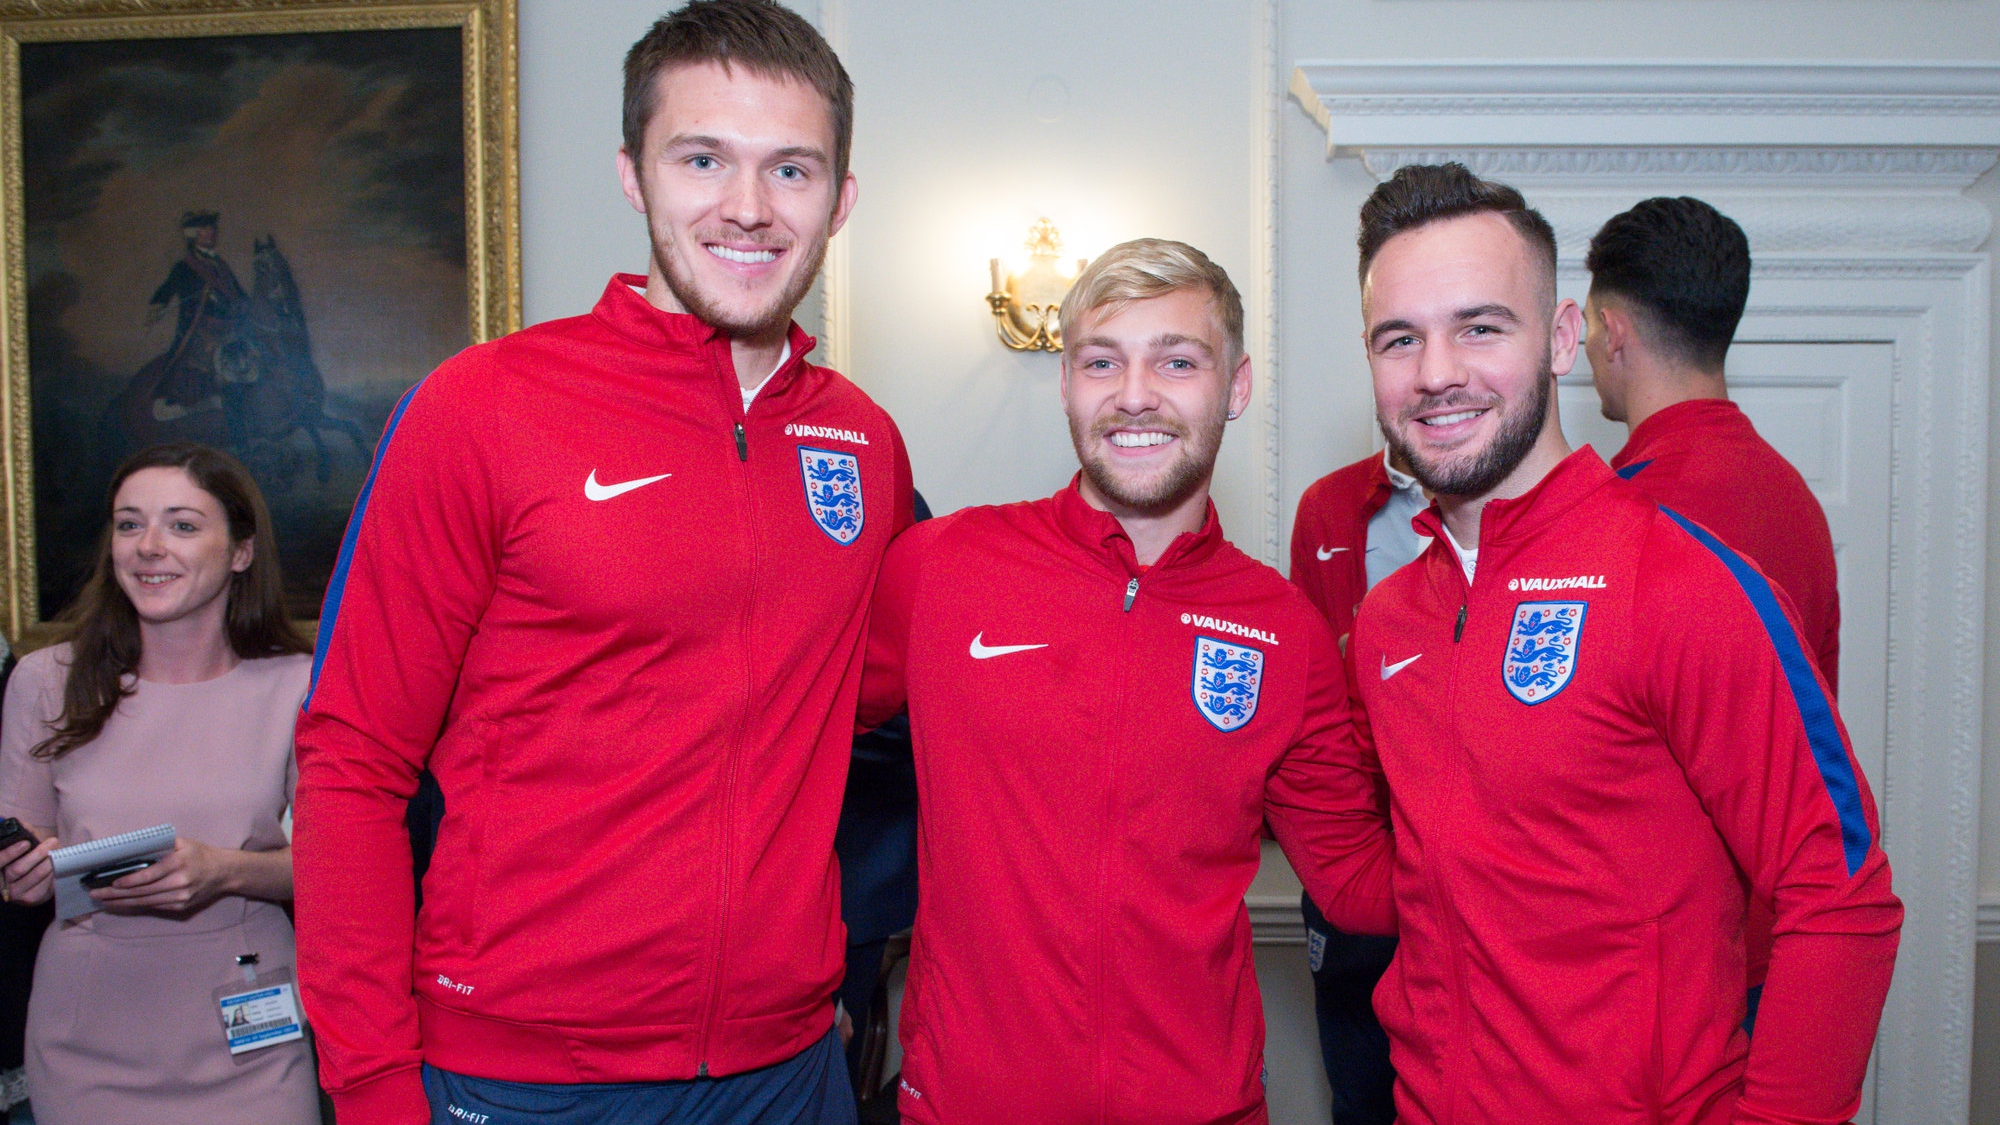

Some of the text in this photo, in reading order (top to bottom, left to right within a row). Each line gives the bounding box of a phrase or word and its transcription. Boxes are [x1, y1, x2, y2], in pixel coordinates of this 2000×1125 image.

[793, 424, 869, 445] VAUXHALL
[1520, 575, 1607, 591] VAUXHALL
[1192, 614, 1279, 645] VAUXHALL
[437, 974, 475, 996] DRI-FIT
[448, 1104, 490, 1125] DRI-FIT
